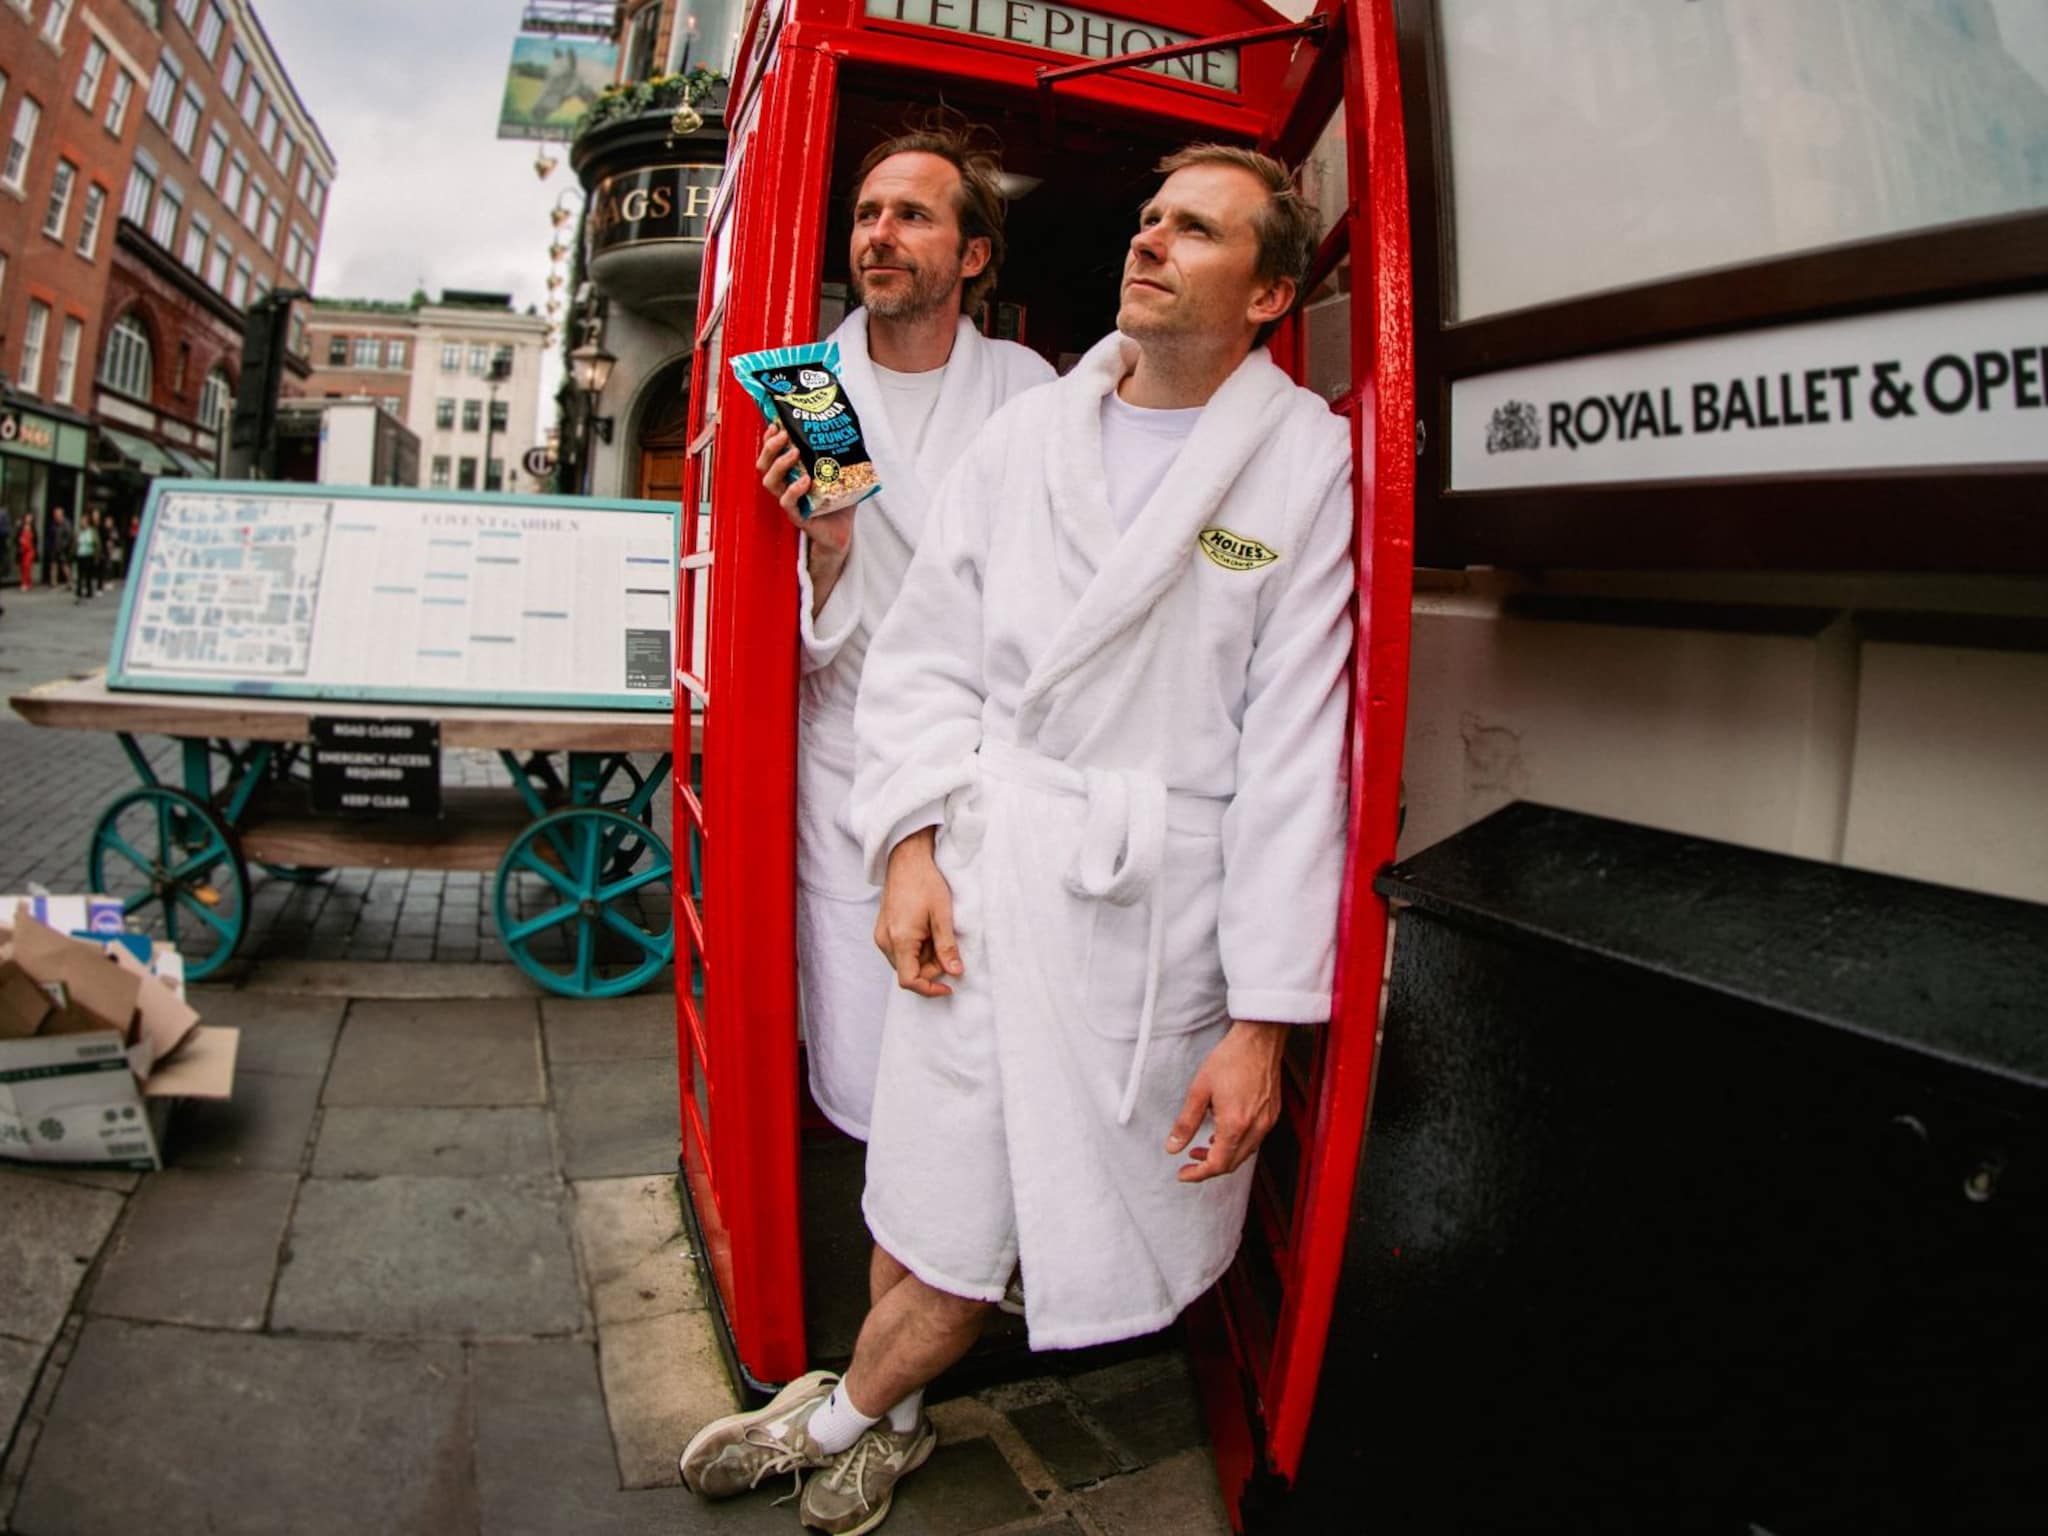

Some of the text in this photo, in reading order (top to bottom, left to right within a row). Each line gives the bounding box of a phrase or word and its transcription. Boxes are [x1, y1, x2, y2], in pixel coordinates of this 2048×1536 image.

[1549, 345, 2048, 451] ROYAL BALLET & OPE
[792, 402, 847, 422] GRANOLA
[803, 412, 853, 433] PROTEIN
[809, 425, 857, 445] CRUNCH
[367, 725, 414, 739] CLOSED
[317, 752, 386, 765] EMERGENCY
